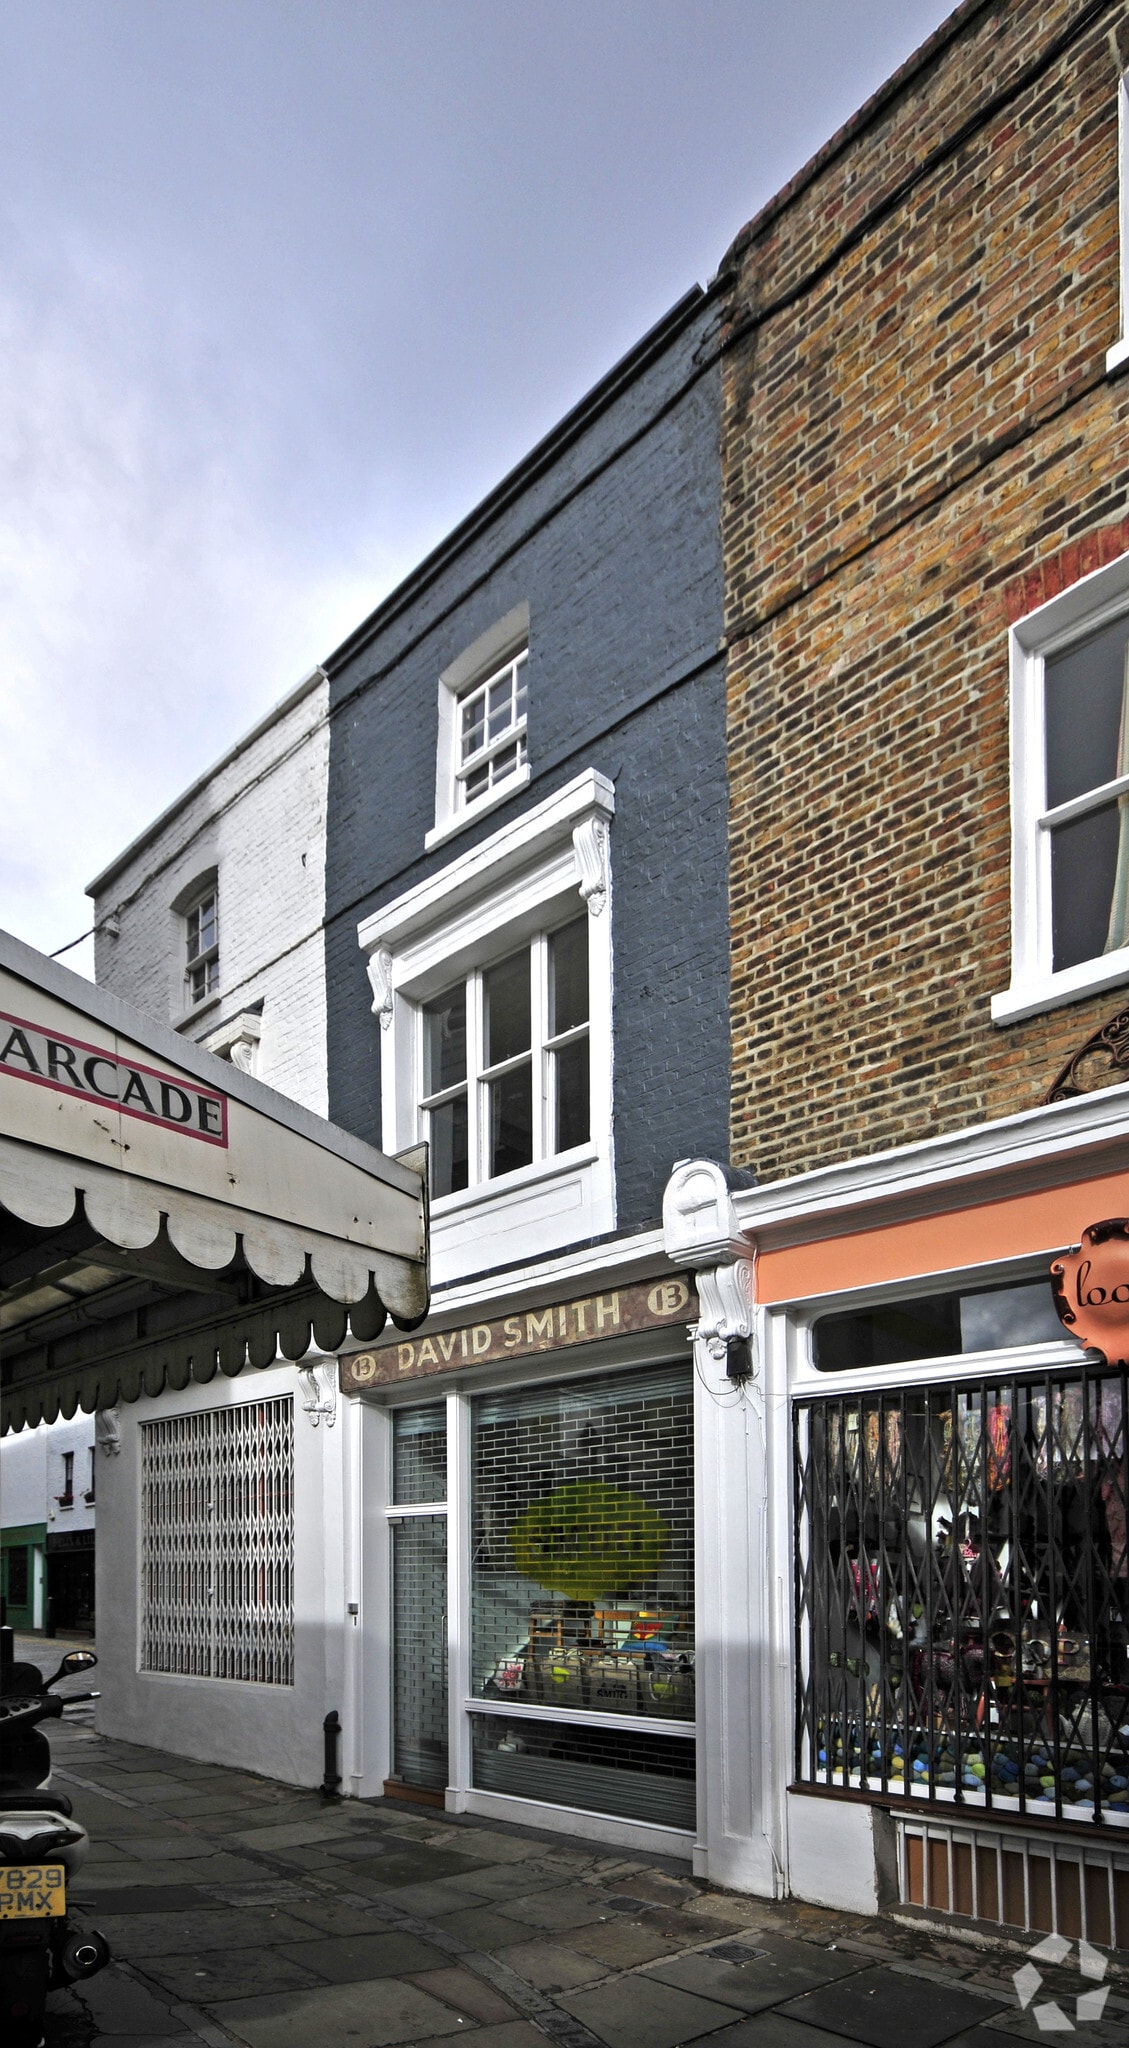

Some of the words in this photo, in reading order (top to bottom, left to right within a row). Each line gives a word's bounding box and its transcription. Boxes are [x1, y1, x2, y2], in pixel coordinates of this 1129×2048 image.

[0, 1024, 223, 1137] ARCADE
[353, 1356, 373, 1379] 13
[396, 1323, 493, 1371] DAVID
[502, 1291, 620, 1347] SMITH
[653, 1283, 684, 1313] 13
